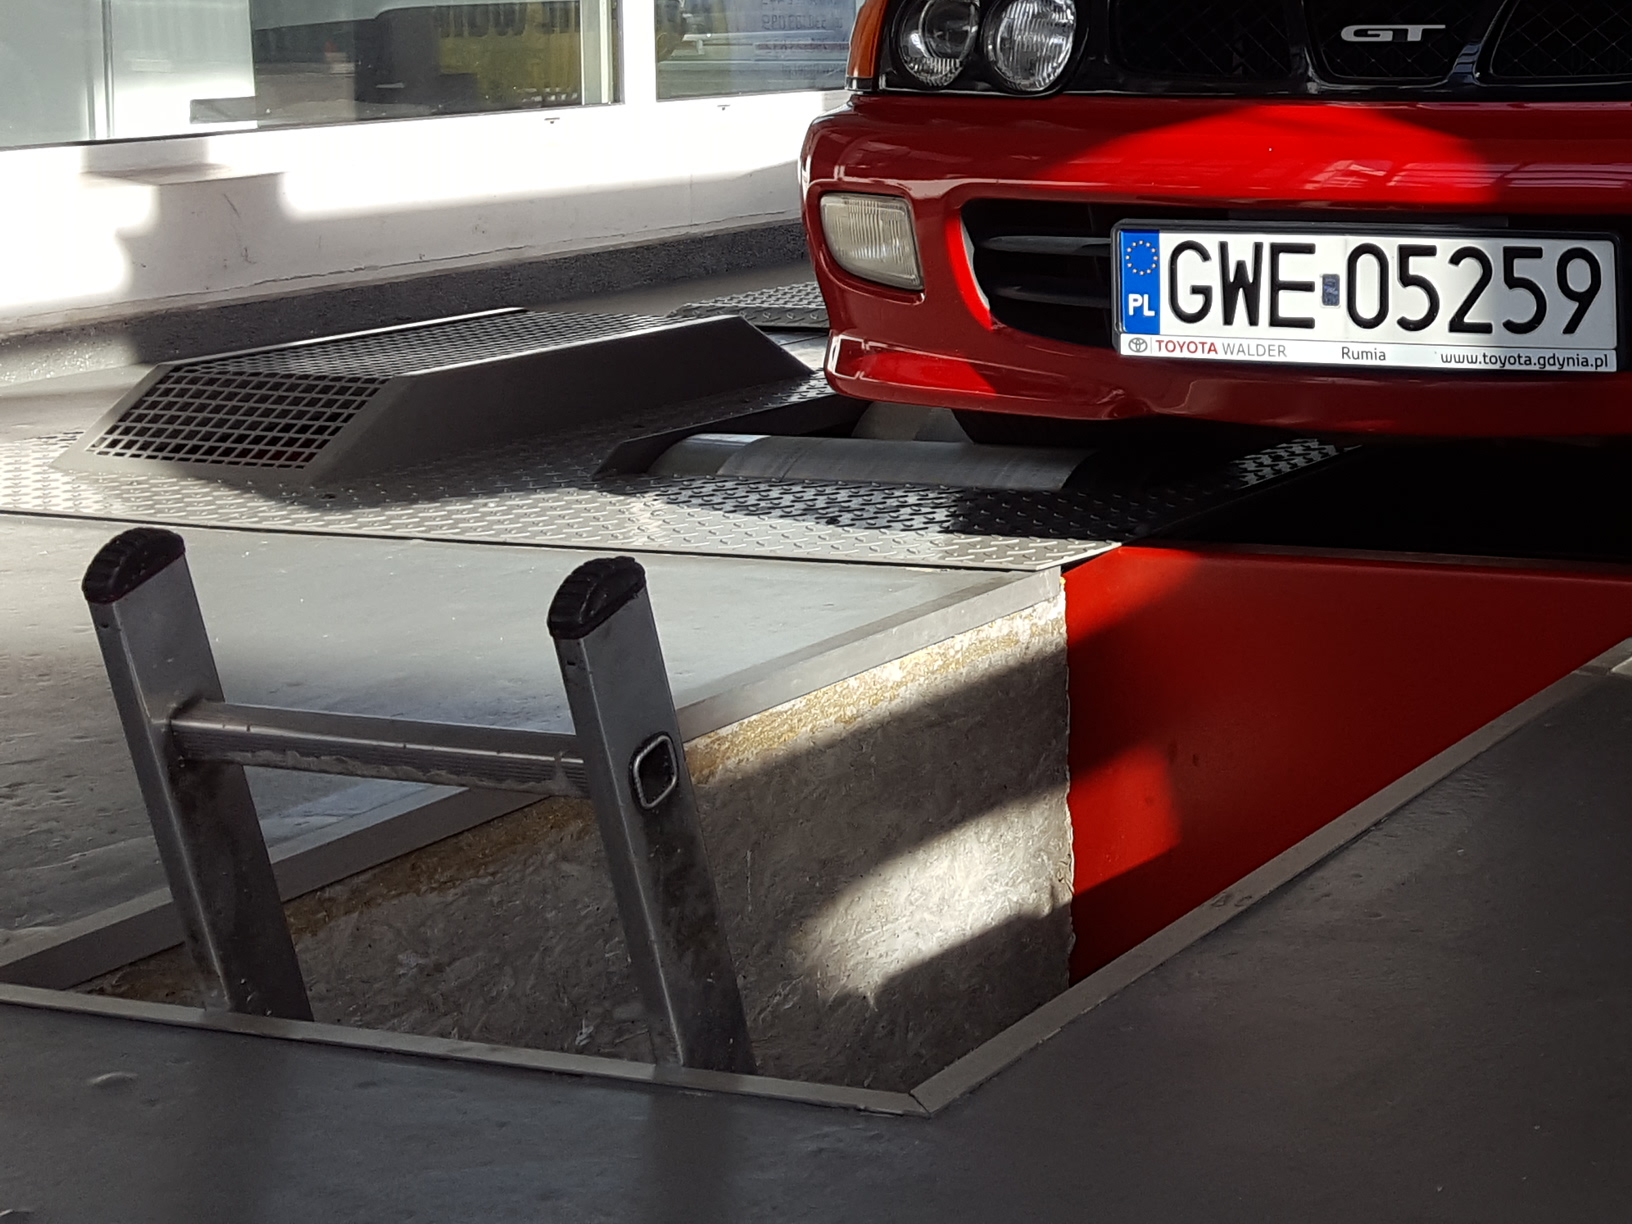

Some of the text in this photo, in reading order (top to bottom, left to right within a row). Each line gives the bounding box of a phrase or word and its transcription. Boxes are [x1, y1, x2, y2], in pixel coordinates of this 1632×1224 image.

[1341, 24, 1446, 42] GT
[1127, 239, 1602, 336] PL GWE 05259
[1155, 338, 1610, 371] TOYOTA WALDER Rumia www.toyota.gdynia.pl
